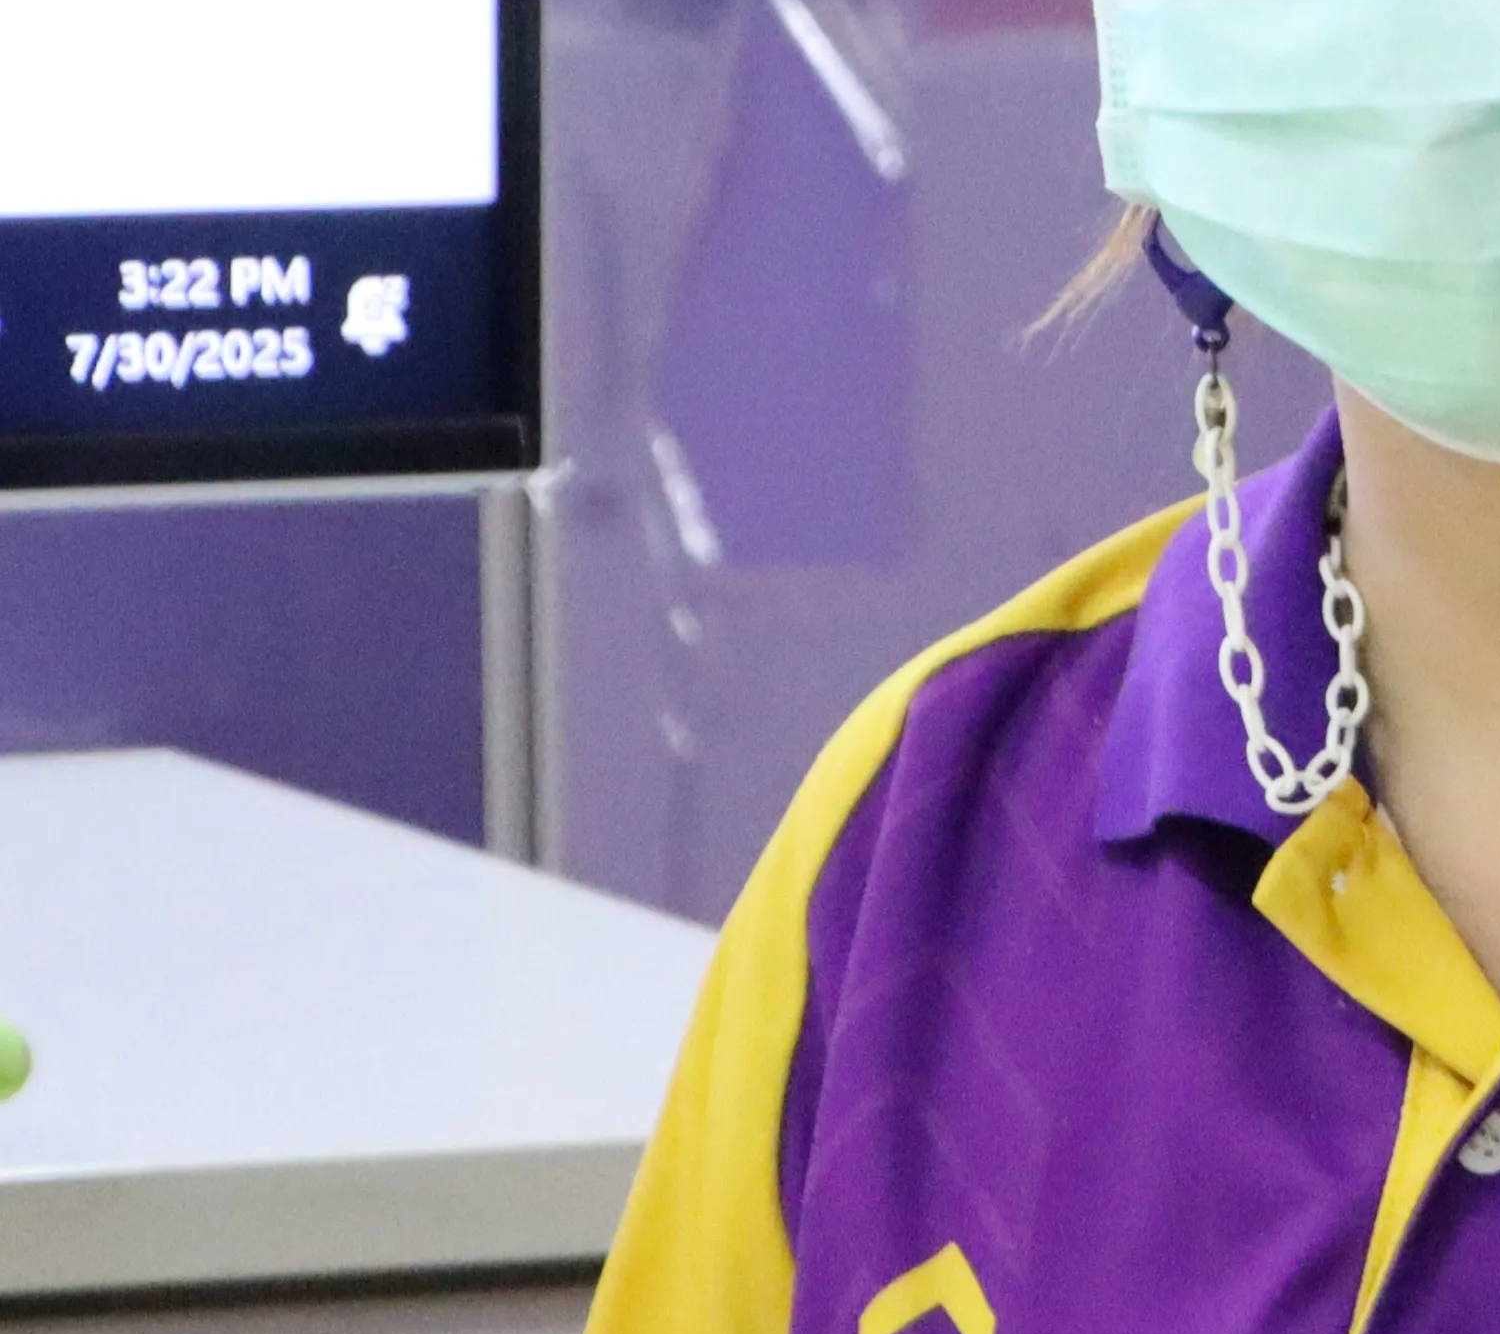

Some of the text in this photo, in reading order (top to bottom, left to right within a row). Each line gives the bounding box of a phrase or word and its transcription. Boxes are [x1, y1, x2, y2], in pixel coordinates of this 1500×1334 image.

[117, 254, 312, 311] 3:22 PM
[64, 325, 314, 391] 7/30/2025
